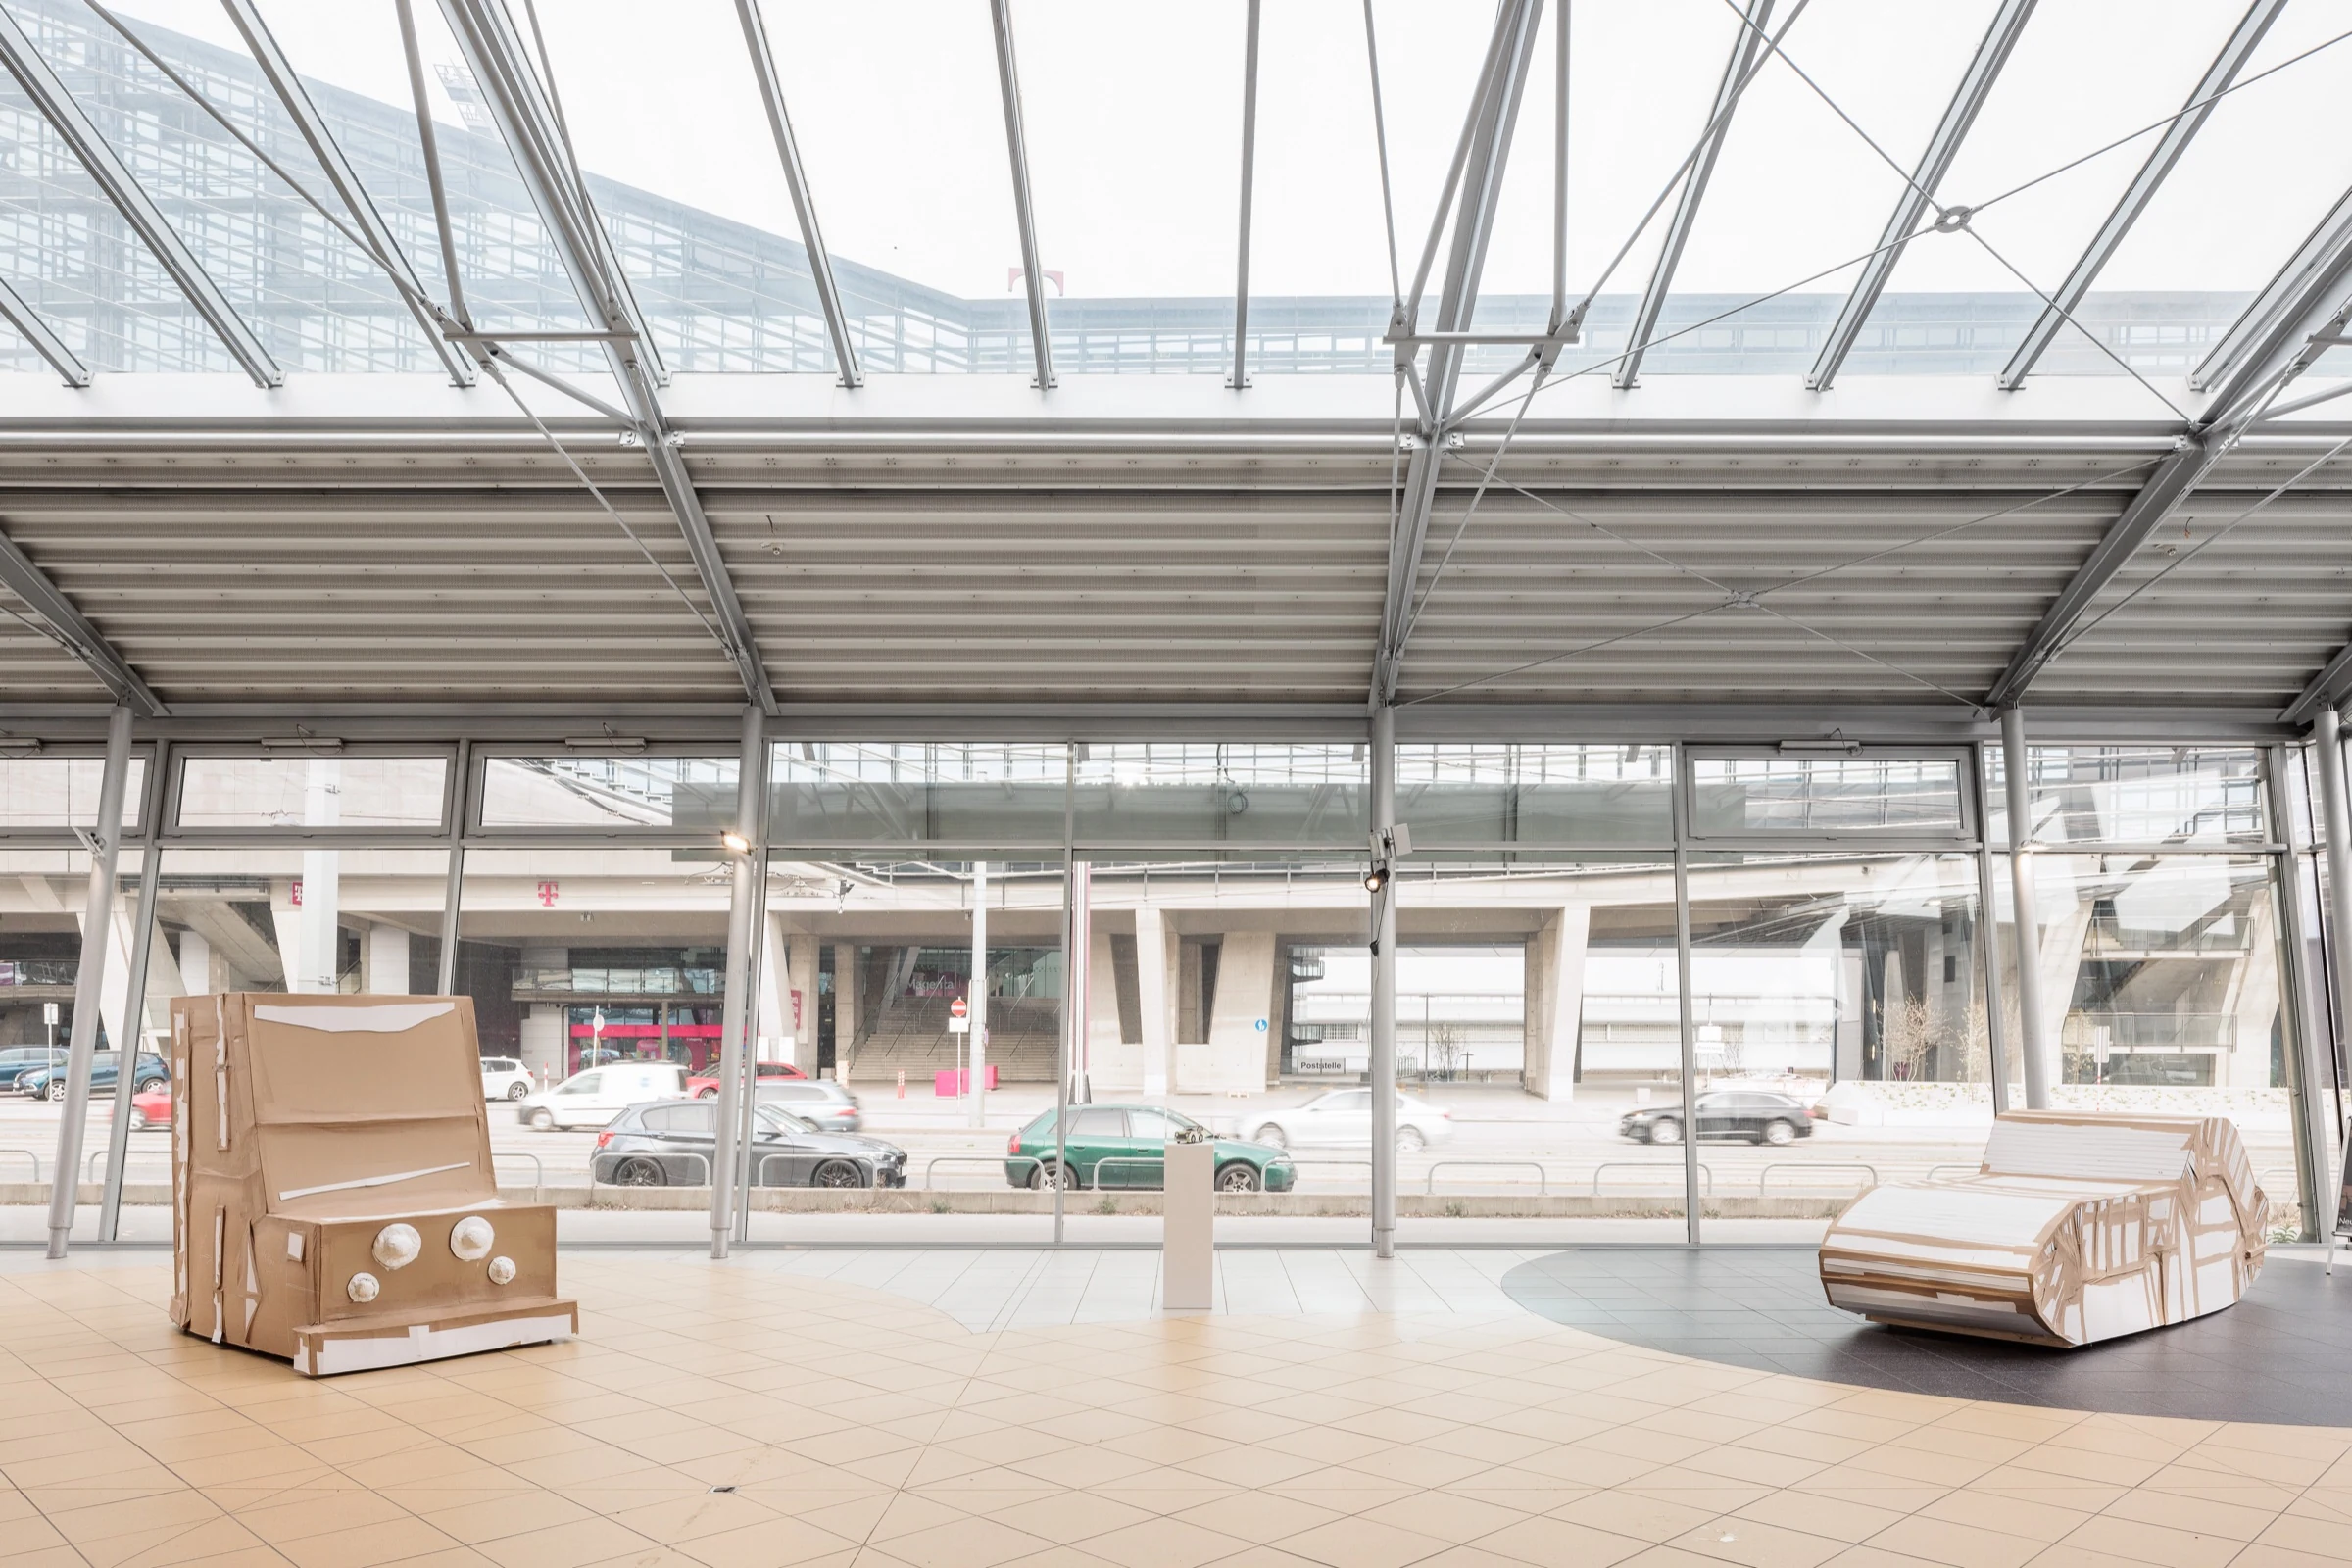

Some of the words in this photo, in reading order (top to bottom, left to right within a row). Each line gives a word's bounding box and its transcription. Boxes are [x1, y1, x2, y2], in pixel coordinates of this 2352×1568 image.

[538, 881, 559, 907] T
[908, 979, 955, 992] Magenta
[1300, 1061, 1342, 1070] Poststelle
